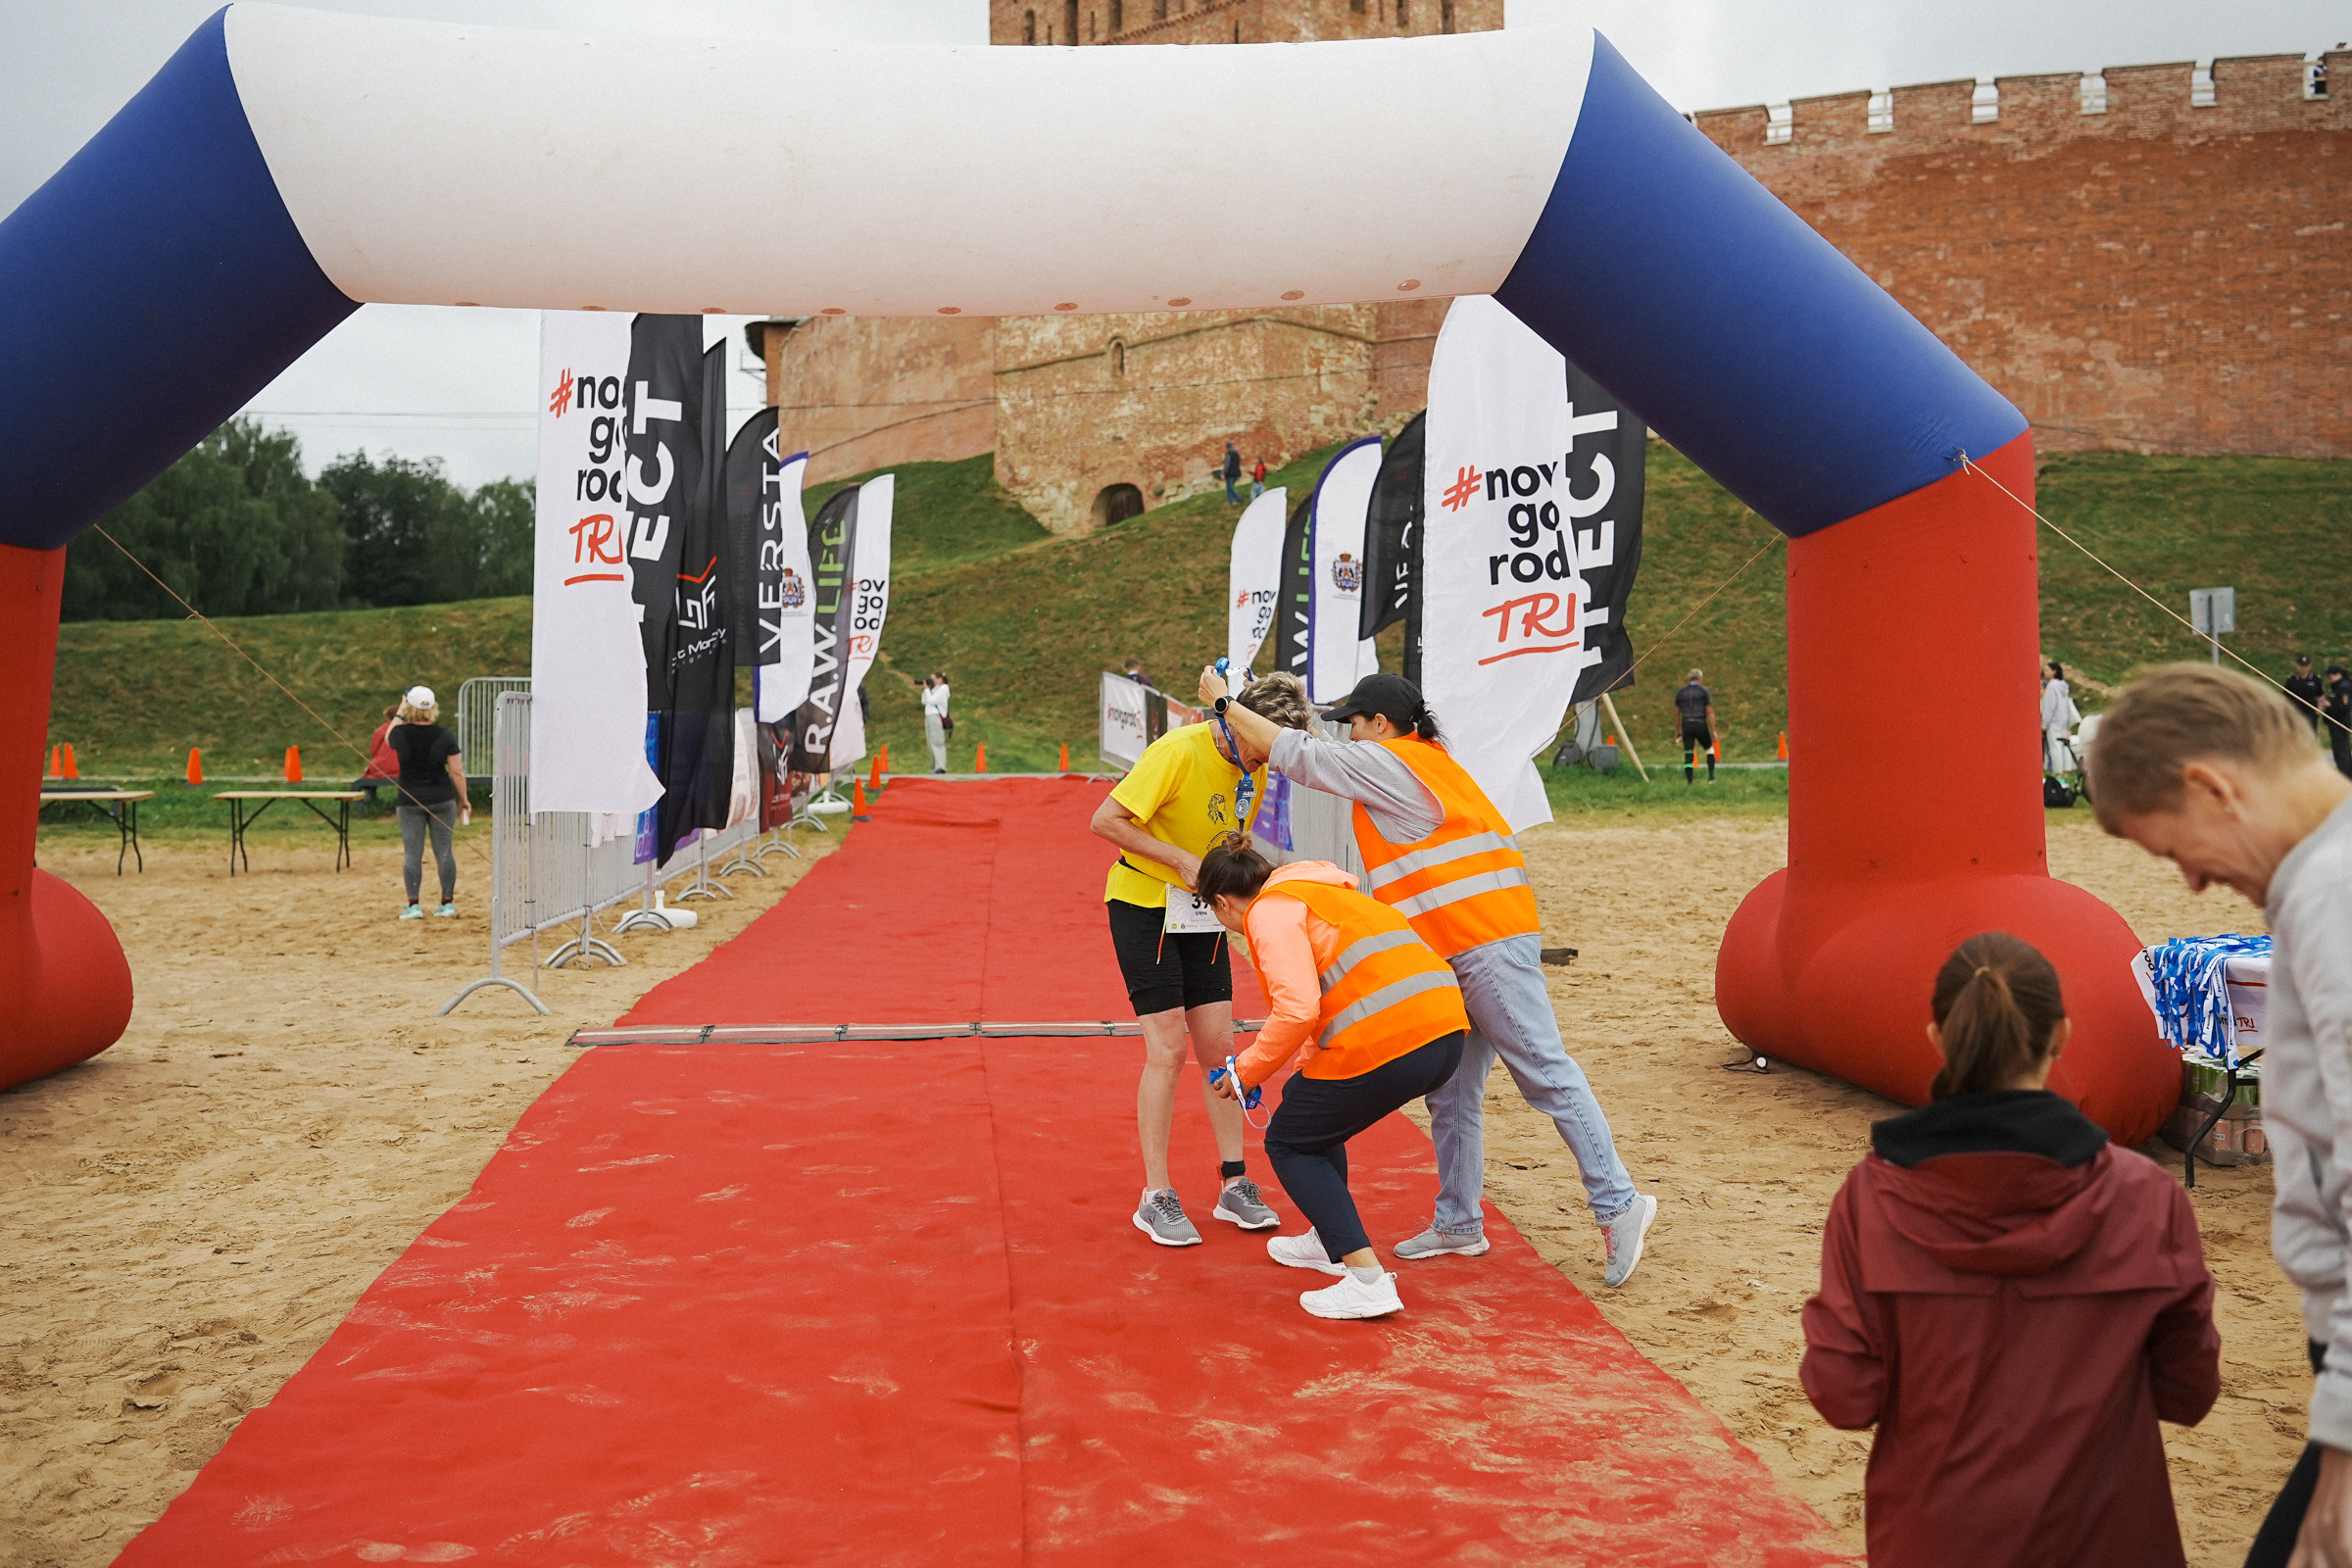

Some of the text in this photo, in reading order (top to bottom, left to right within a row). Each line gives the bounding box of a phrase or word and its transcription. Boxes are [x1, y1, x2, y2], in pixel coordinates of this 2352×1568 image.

[1441, 461, 1558, 513] #nov
[1508, 501, 1560, 548] go
[1489, 530, 1571, 585] rod
[1482, 592, 1577, 643] TRI
